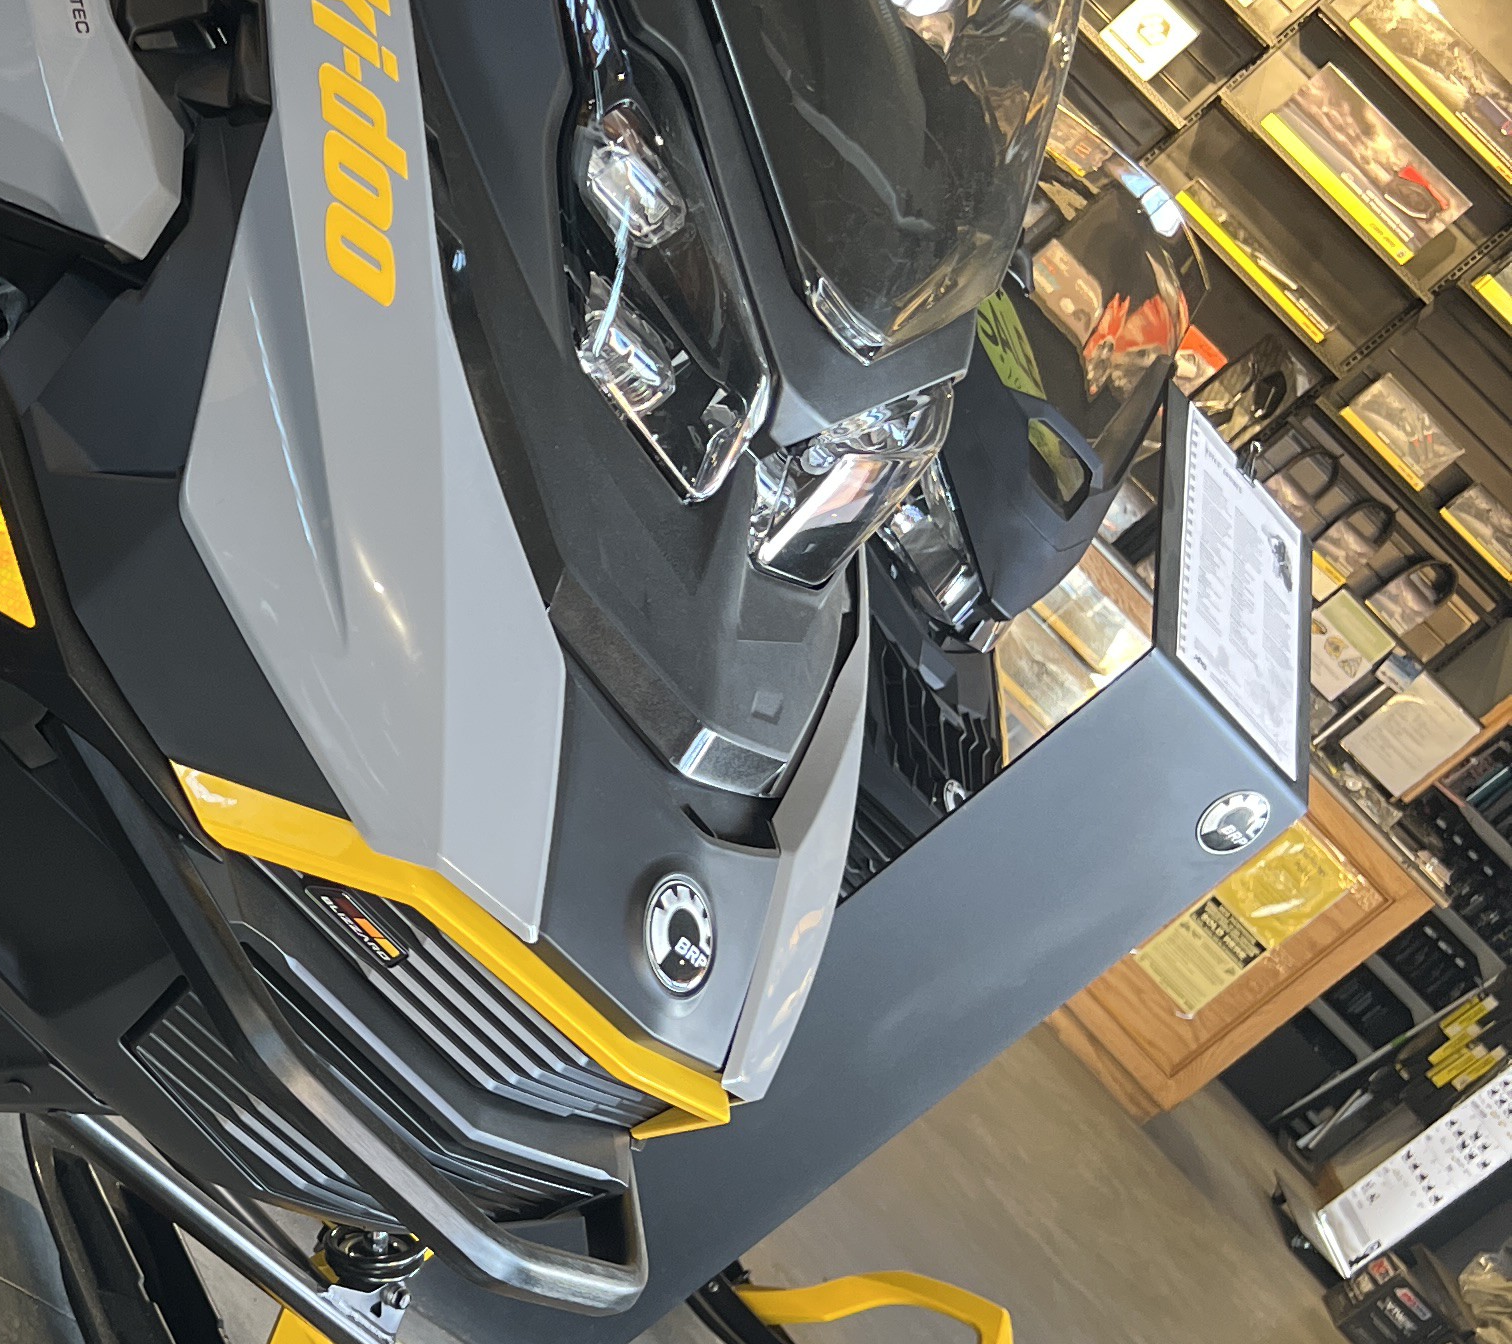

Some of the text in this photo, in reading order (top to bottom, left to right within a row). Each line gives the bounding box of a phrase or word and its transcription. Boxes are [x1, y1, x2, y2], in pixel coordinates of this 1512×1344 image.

[1221, 825, 1249, 849] BRP
[321, 895, 390, 962] BLIZZARD
[674, 937, 710, 968] BRP
